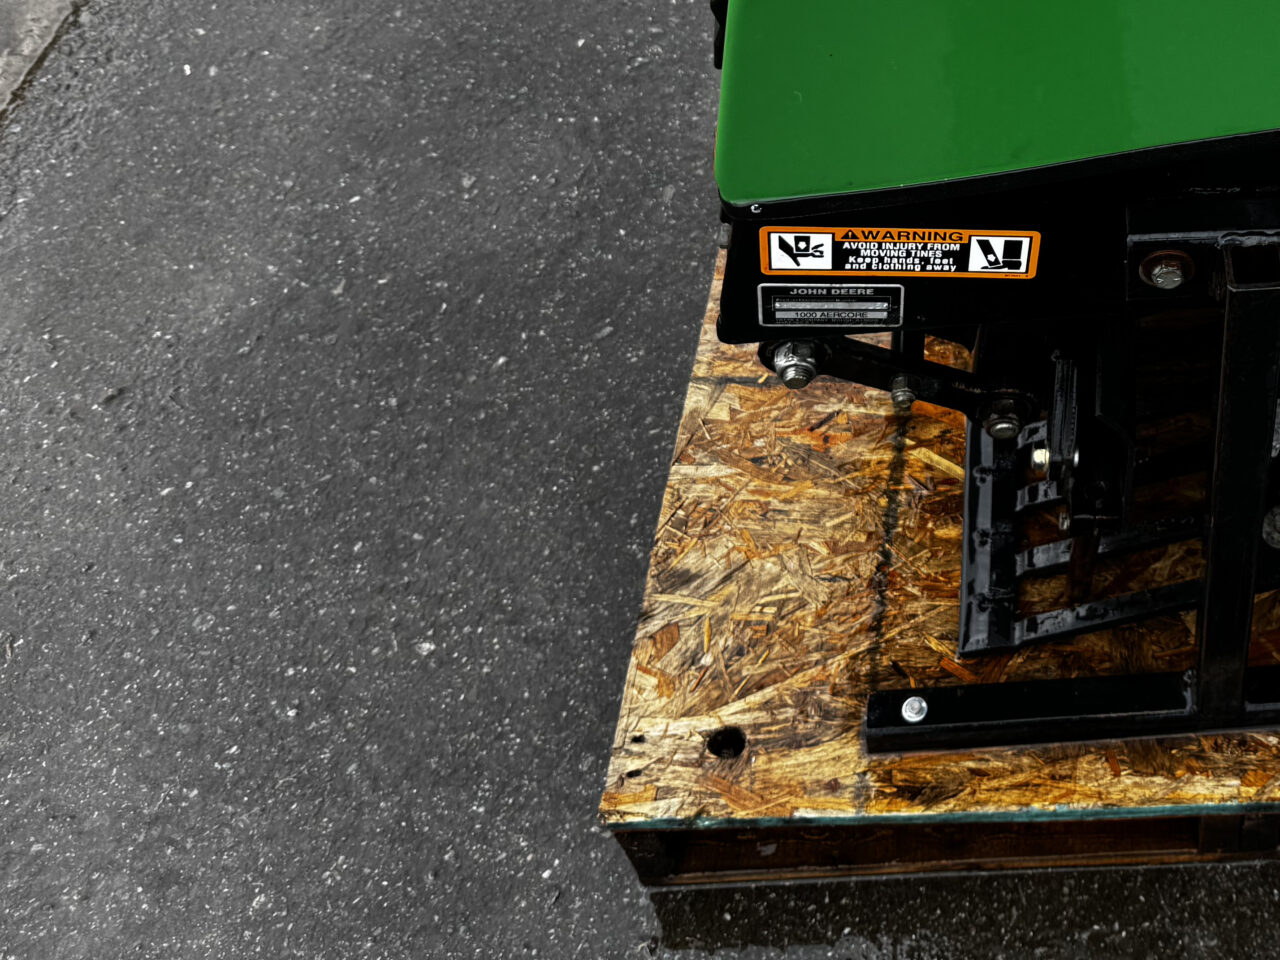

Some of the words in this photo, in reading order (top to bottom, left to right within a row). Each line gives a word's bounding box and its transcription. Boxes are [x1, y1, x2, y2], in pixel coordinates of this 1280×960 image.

[861, 230, 964, 242] WARNING
[882, 242, 923, 250] INJURY
[927, 243, 960, 251] FROM
[860, 249, 906, 257] MOVING
[910, 250, 942, 258] TINES
[848, 256, 879, 265] Keep
[884, 256, 925, 265] hands,
[930, 257, 954, 265] feet
[871, 263, 921, 271] clothing
[926, 264, 957, 272] away
